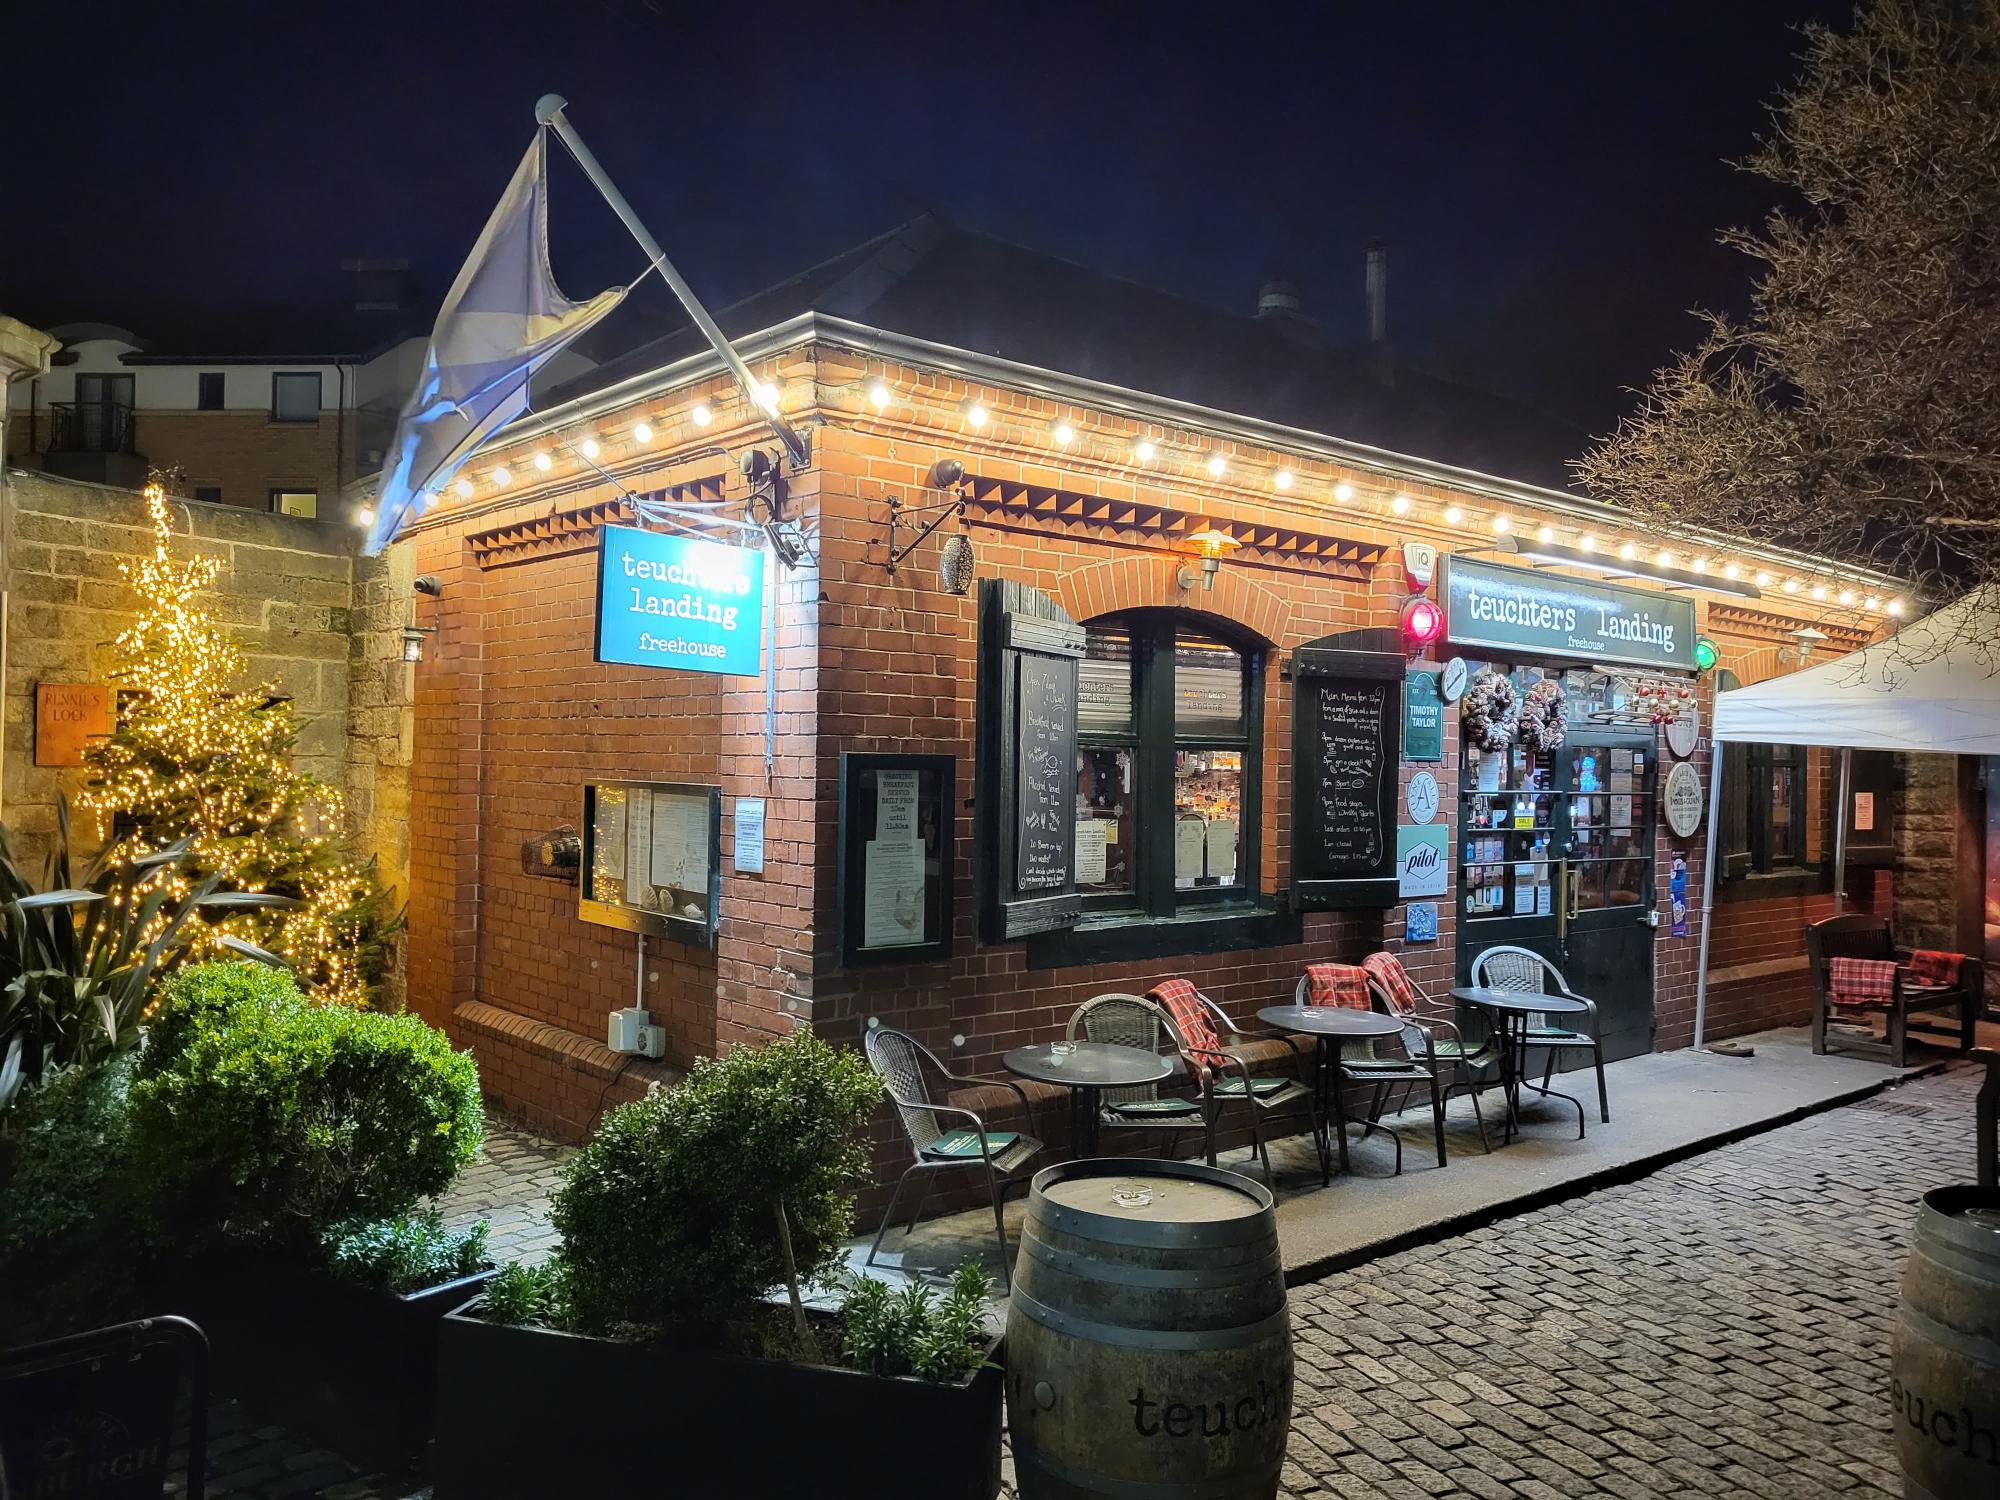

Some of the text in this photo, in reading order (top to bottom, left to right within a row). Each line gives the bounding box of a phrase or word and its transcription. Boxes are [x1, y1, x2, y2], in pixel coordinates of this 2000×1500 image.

[629, 587, 738, 630] landing
[1468, 586, 1675, 653] teuchters landing
[638, 633, 727, 659] freehouse
[1567, 635, 1605, 652] freehouse
[53, 709, 89, 721] LOCK
[1187, 701, 1224, 713] landing
[1410, 705, 1438, 716] TIMOTHY
[1412, 718, 1436, 728] TAYLOR
[1406, 847, 1439, 876] pilot
